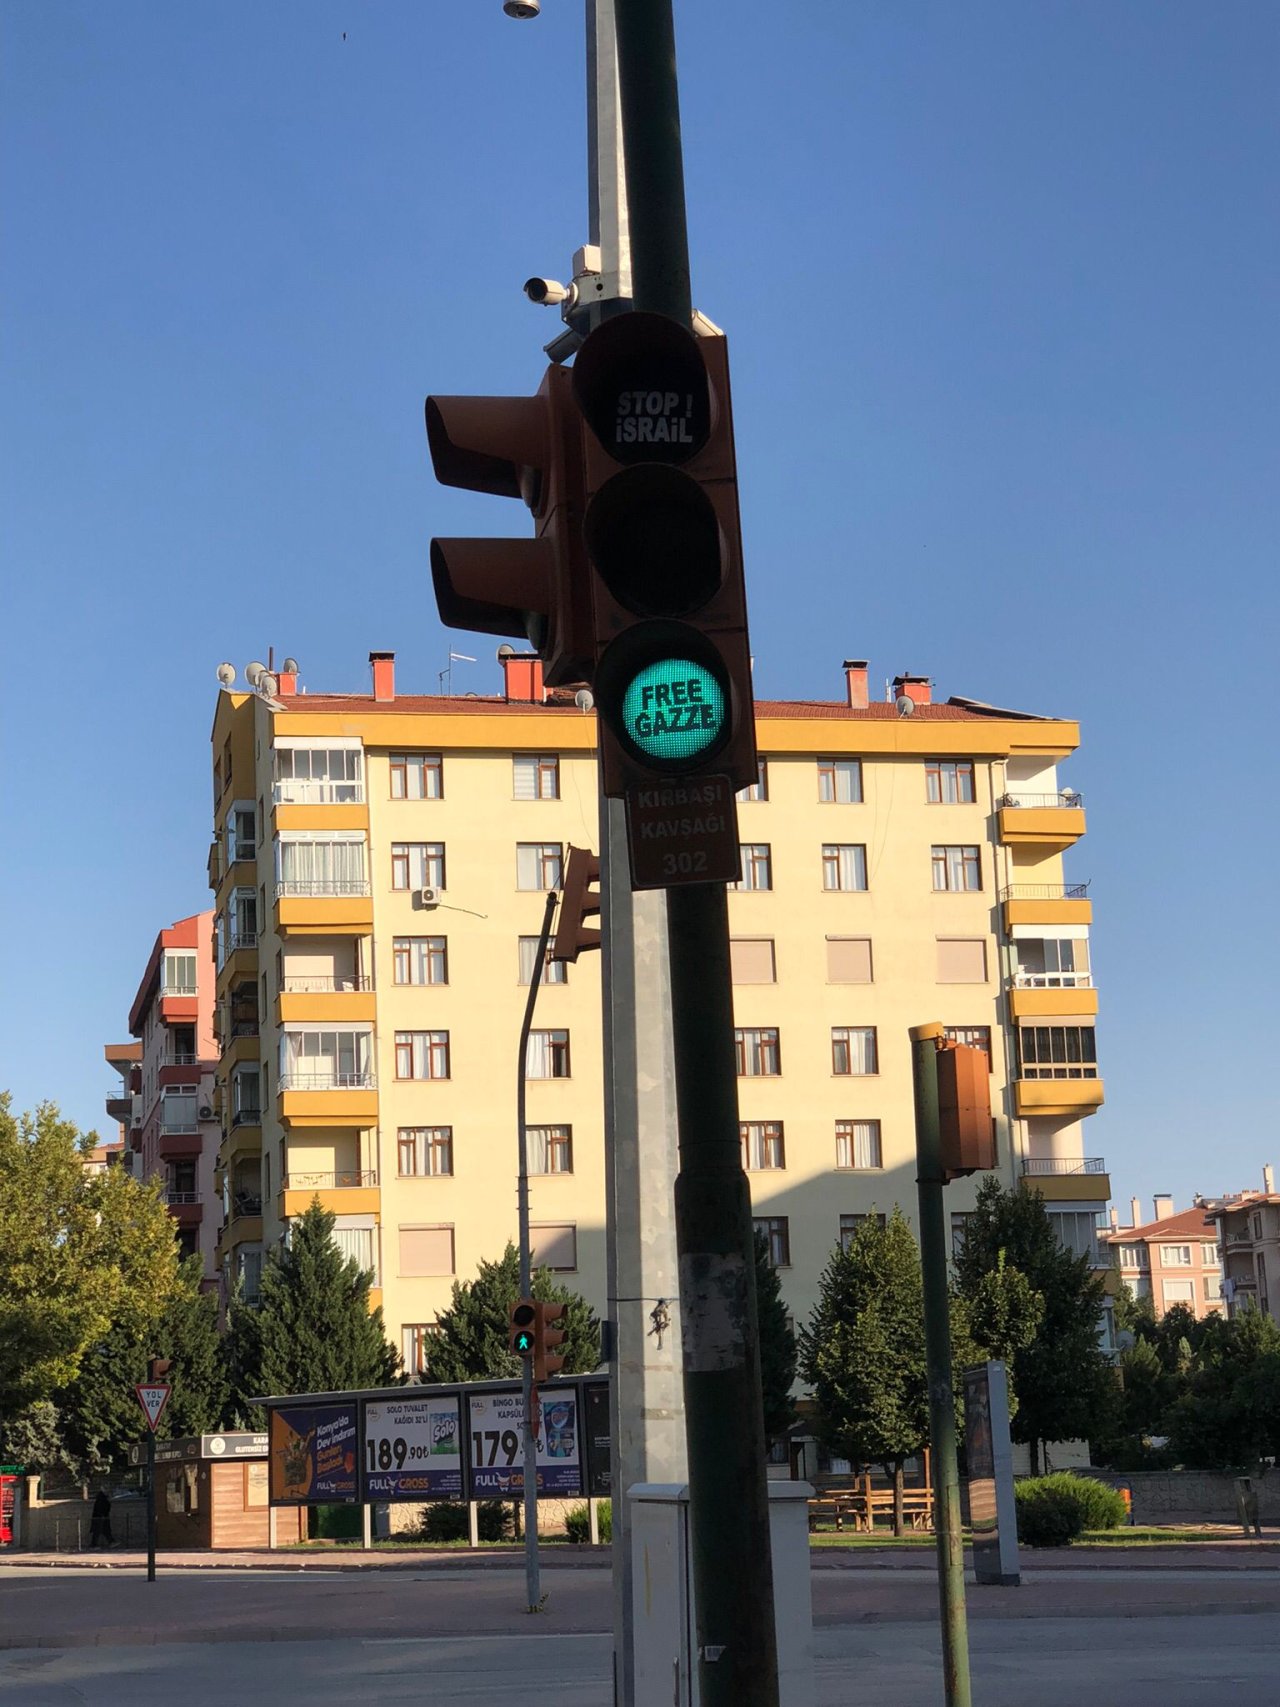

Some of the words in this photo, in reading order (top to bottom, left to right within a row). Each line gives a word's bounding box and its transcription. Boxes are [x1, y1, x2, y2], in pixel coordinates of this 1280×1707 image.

[616, 390, 680, 416] STOP
[642, 679, 702, 710] FREE
[635, 704, 716, 737] GAZZE
[638, 784, 721, 809] KIRBAŞI
[640, 812, 725, 840] KAVŞAĞI
[662, 851, 708, 875] 302
[387, 1406, 402, 1414] SOLO
[404, 1404, 428, 1413] TUVALET
[369, 1478, 388, 1490] FULL
[398, 1477, 429, 1489] GROSS
[475, 1474, 498, 1487] FULL
[510, 1472, 544, 1487] GRS
